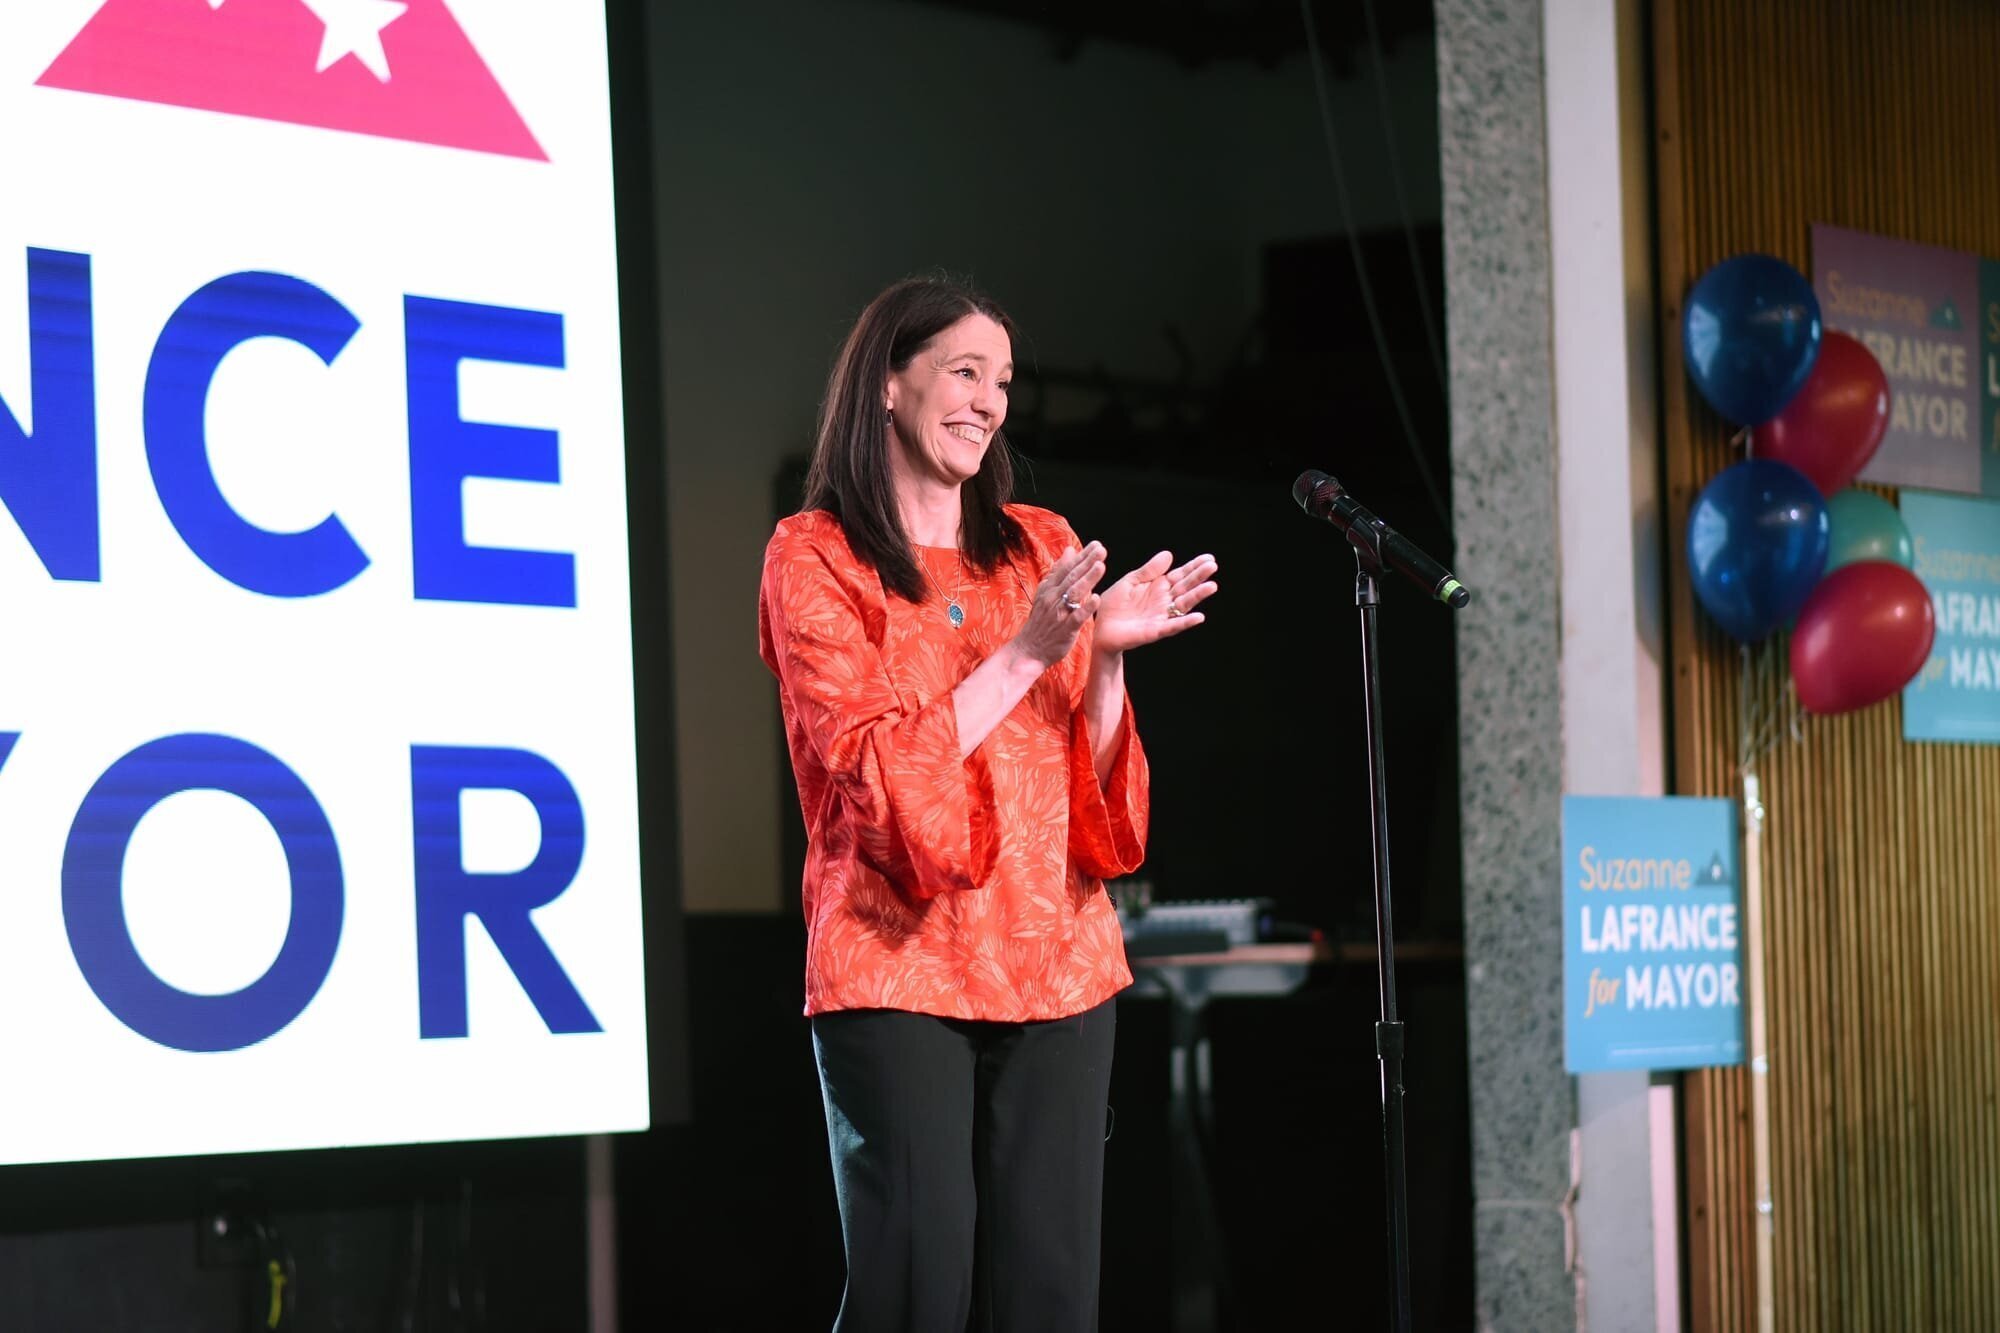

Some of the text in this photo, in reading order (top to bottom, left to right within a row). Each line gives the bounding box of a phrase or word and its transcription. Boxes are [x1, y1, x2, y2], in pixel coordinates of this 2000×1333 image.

[1892, 391, 1969, 441] AYOR
[0, 731, 605, 1053] OR
[1579, 846, 1691, 892] Suzanne
[1581, 903, 1738, 953] LAFRANCE
[1584, 963, 1739, 1019] for MAYOR
